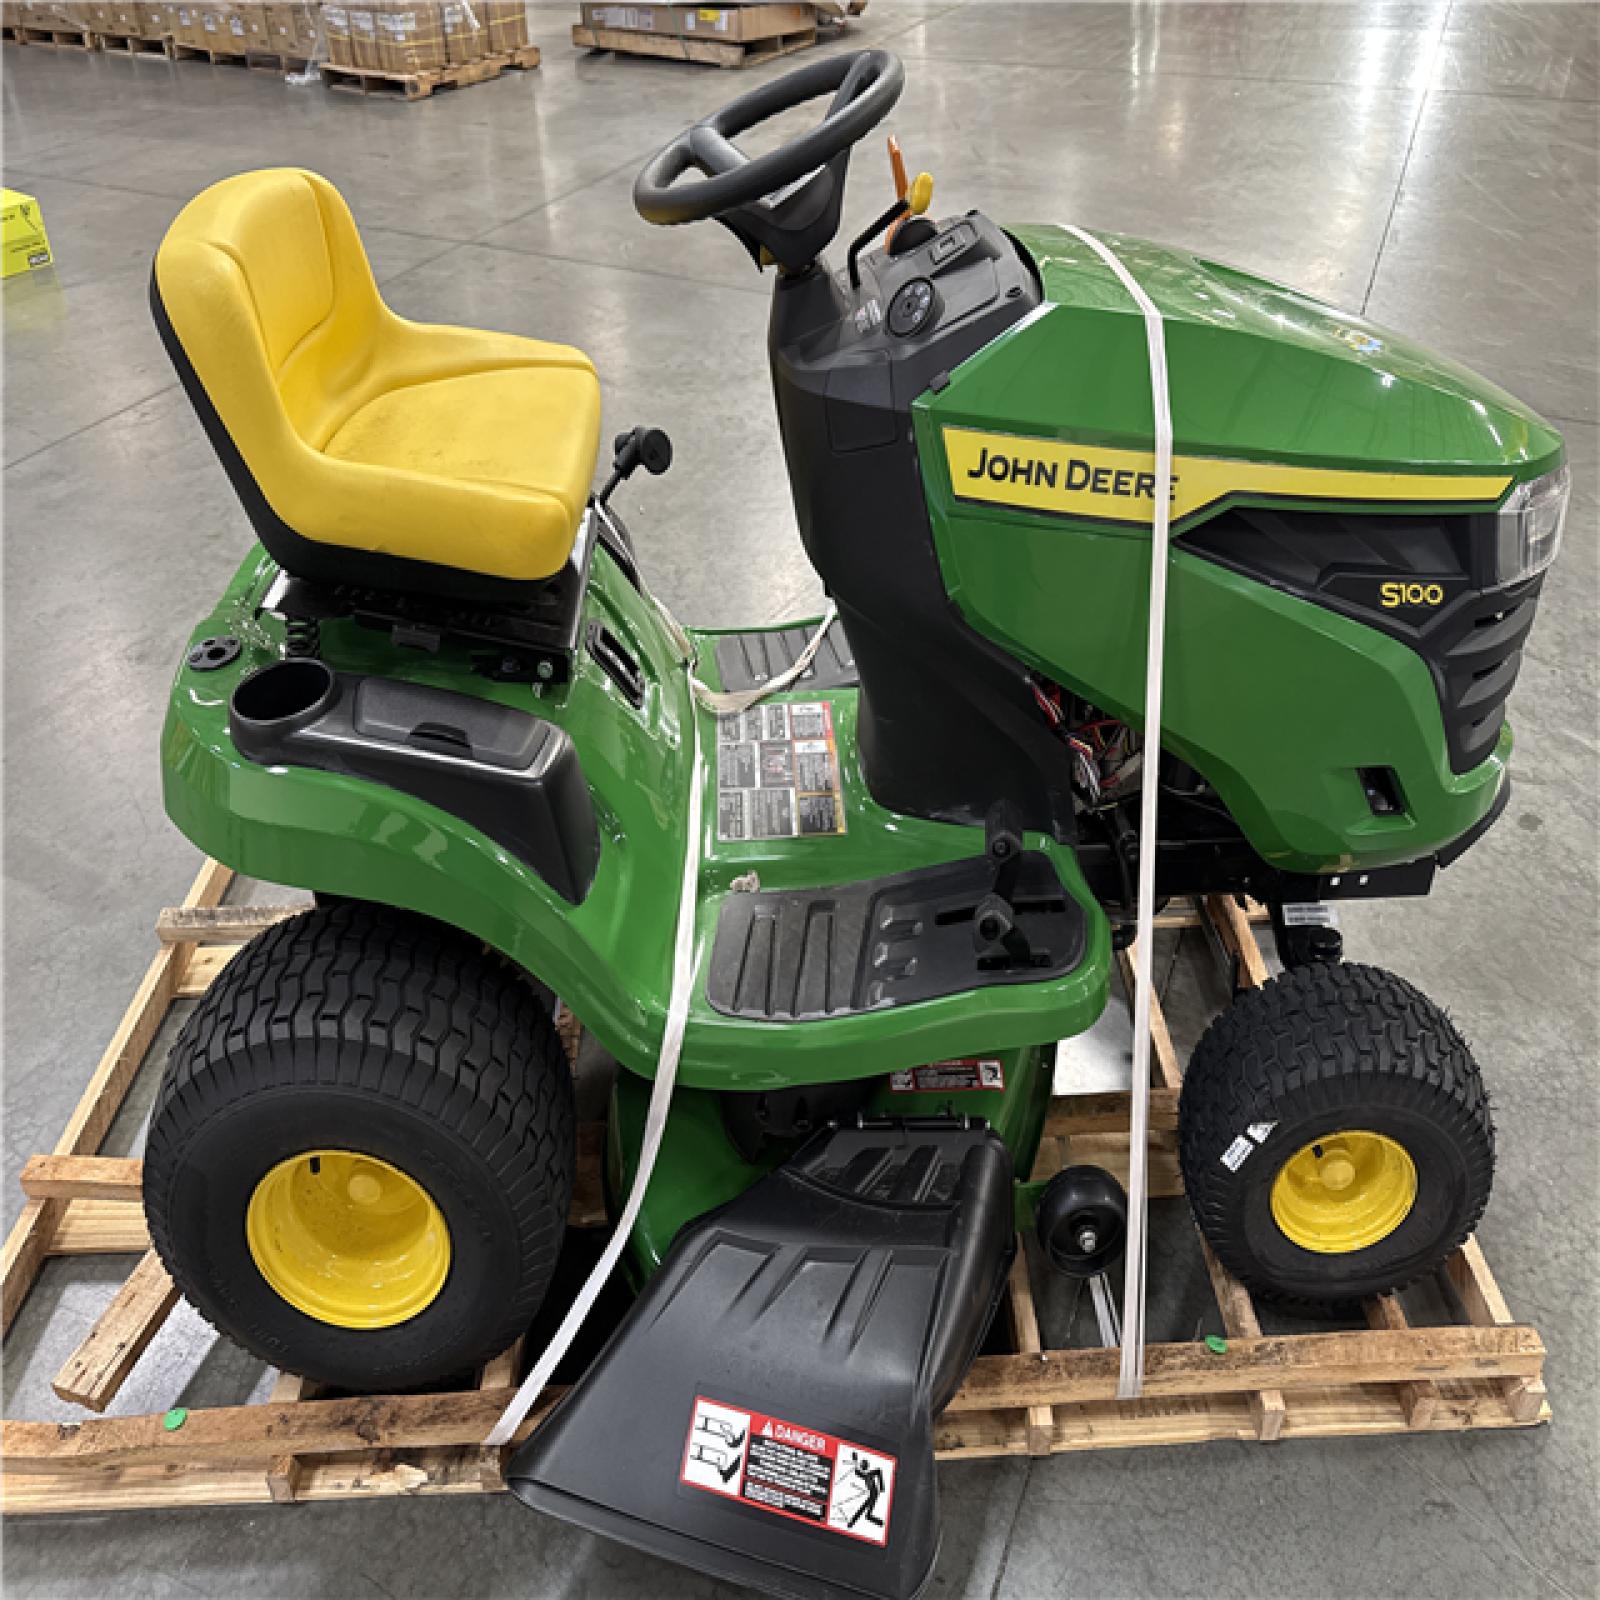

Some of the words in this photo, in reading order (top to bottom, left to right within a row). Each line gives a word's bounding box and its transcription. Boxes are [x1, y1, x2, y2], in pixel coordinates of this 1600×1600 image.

[967, 447, 1058, 489] JOHN
[1380, 582, 1443, 608] S100
[773, 1423, 827, 1450] DANGER
